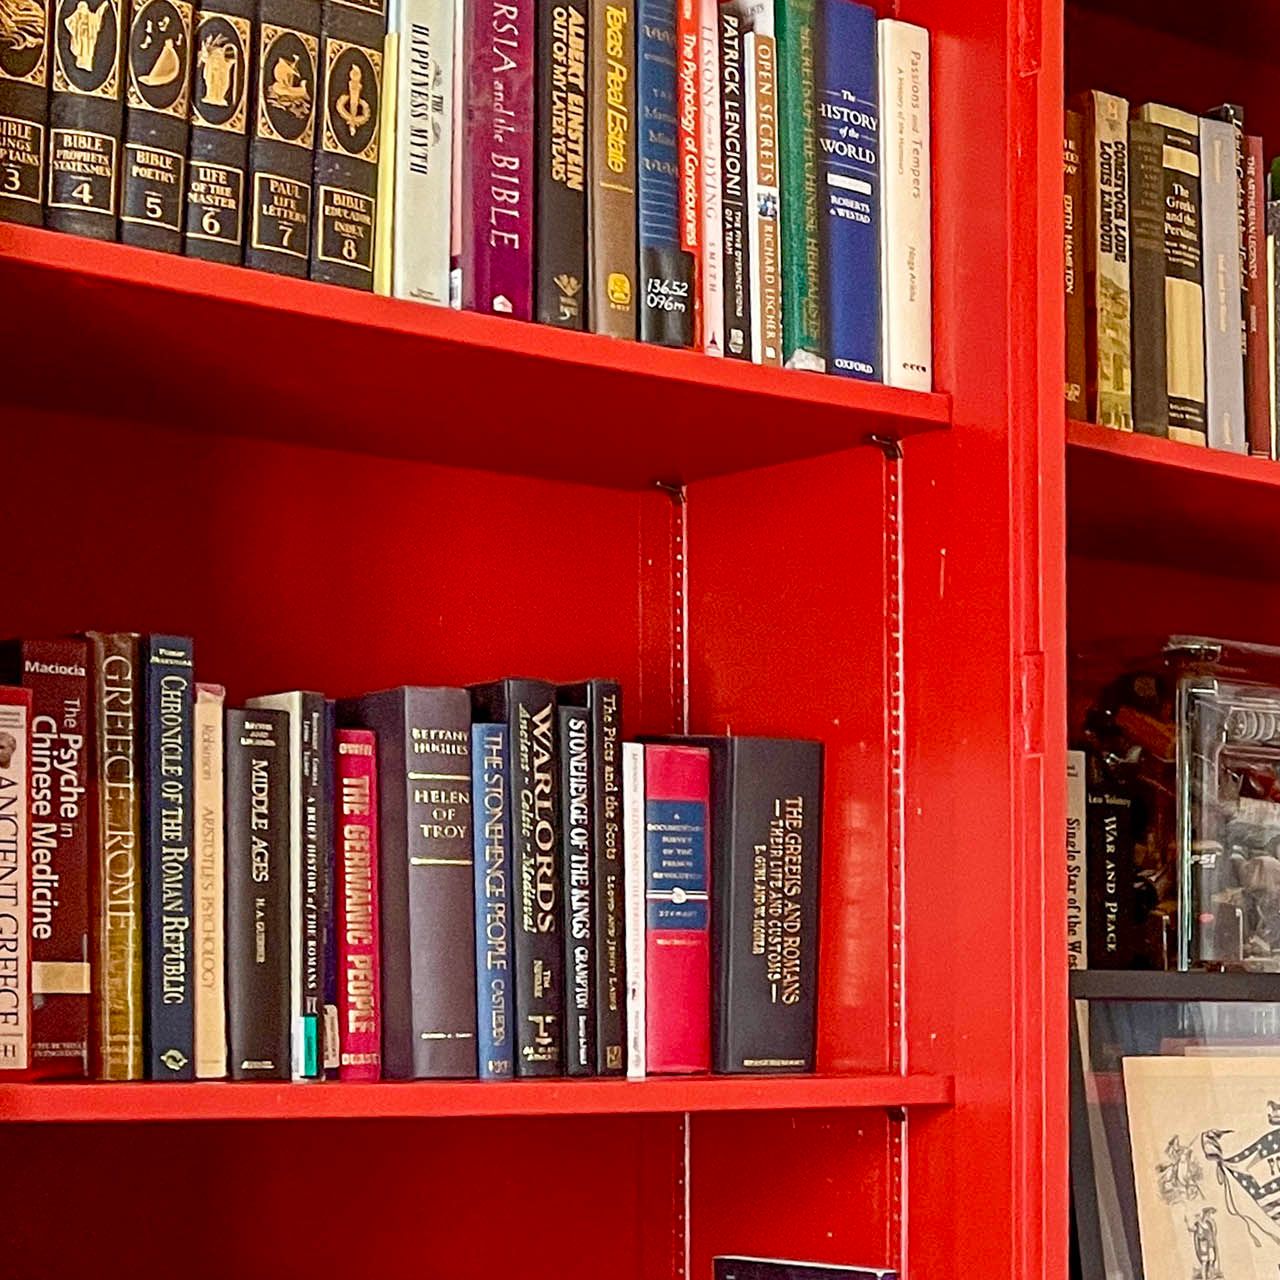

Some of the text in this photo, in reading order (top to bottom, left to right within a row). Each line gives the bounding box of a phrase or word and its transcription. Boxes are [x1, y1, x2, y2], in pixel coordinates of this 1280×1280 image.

[410, 24, 430, 175] HAPPINESS MYTH
[566, 5, 586, 192] ALBERT EINSTEIN
[605, 5, 628, 174] Texas Real Estate
[722, 14, 742, 197] PATRICK LENCIONI
[756, 44, 775, 184] OPEN SECRETS
[818, 103, 878, 132] HISTORY
[63, 134, 104, 152] BIBLE
[136, 150, 174, 169] BIBLE
[820, 138, 876, 165] WORLD
[4, 168, 21, 192] 3
[71, 182, 94, 205] 4
[131, 166, 176, 184] POETRY
[199, 167, 228, 184] LIFE
[270, 179, 301, 199] PAUL
[146, 196, 163, 218] 5
[187, 192, 237, 210] MASTER
[201, 211, 221, 235] 6
[830, 195, 871, 214] ROBERTS
[1113, 140, 1127, 264] COMSTOCK LODE
[279, 225, 294, 247] 7
[342, 238, 358, 261] 8
[763, 224, 777, 340] RICHARD LISCHER
[834, 358, 874, 374] OXFORD
[25, 661, 86, 677] Maciocia
[160, 676, 189, 776] CHRONICLE
[411, 727, 469, 742] BETTANY
[52, 698, 86, 838] The Psyche in
[567, 718, 588, 826] STONEHENGE
[101, 655, 137, 930] GREECE ROME
[162, 780, 184, 802] OF
[251, 759, 269, 831] MIDDLE
[343, 776, 369, 816] THE
[414, 789, 470, 805] HELEN
[31, 715, 59, 939] Chinese Medicine
[162, 807, 185, 841] THE
[420, 824, 467, 839] TROY
[432, 808, 456, 820] OF
[518, 703, 537, 933] Ancient Celtic Medieval
[531, 703, 556, 933] WARLORDS
[252, 835, 269, 883] AGES
[570, 827, 589, 849] OF
[162, 845, 189, 911] ROMAN
[344, 824, 372, 945] GERMANIC
[483, 732, 508, 1047] THE STONEHENGE PEOPLE CASTLEDEN
[570, 851, 588, 887] THE
[1103, 816, 1119, 953] WAR AND PEACE
[570, 888, 590, 939] KINGS
[767, 819, 783, 981] THEIR LIFE AND CUSTOMS
[780, 796, 803, 1005] THE GREEKS AND ROMANS
[162, 915, 189, 1005] REPUBLIC
[575, 946, 590, 1009] CRAMPTON
[347, 954, 375, 1033] PEOPLE
